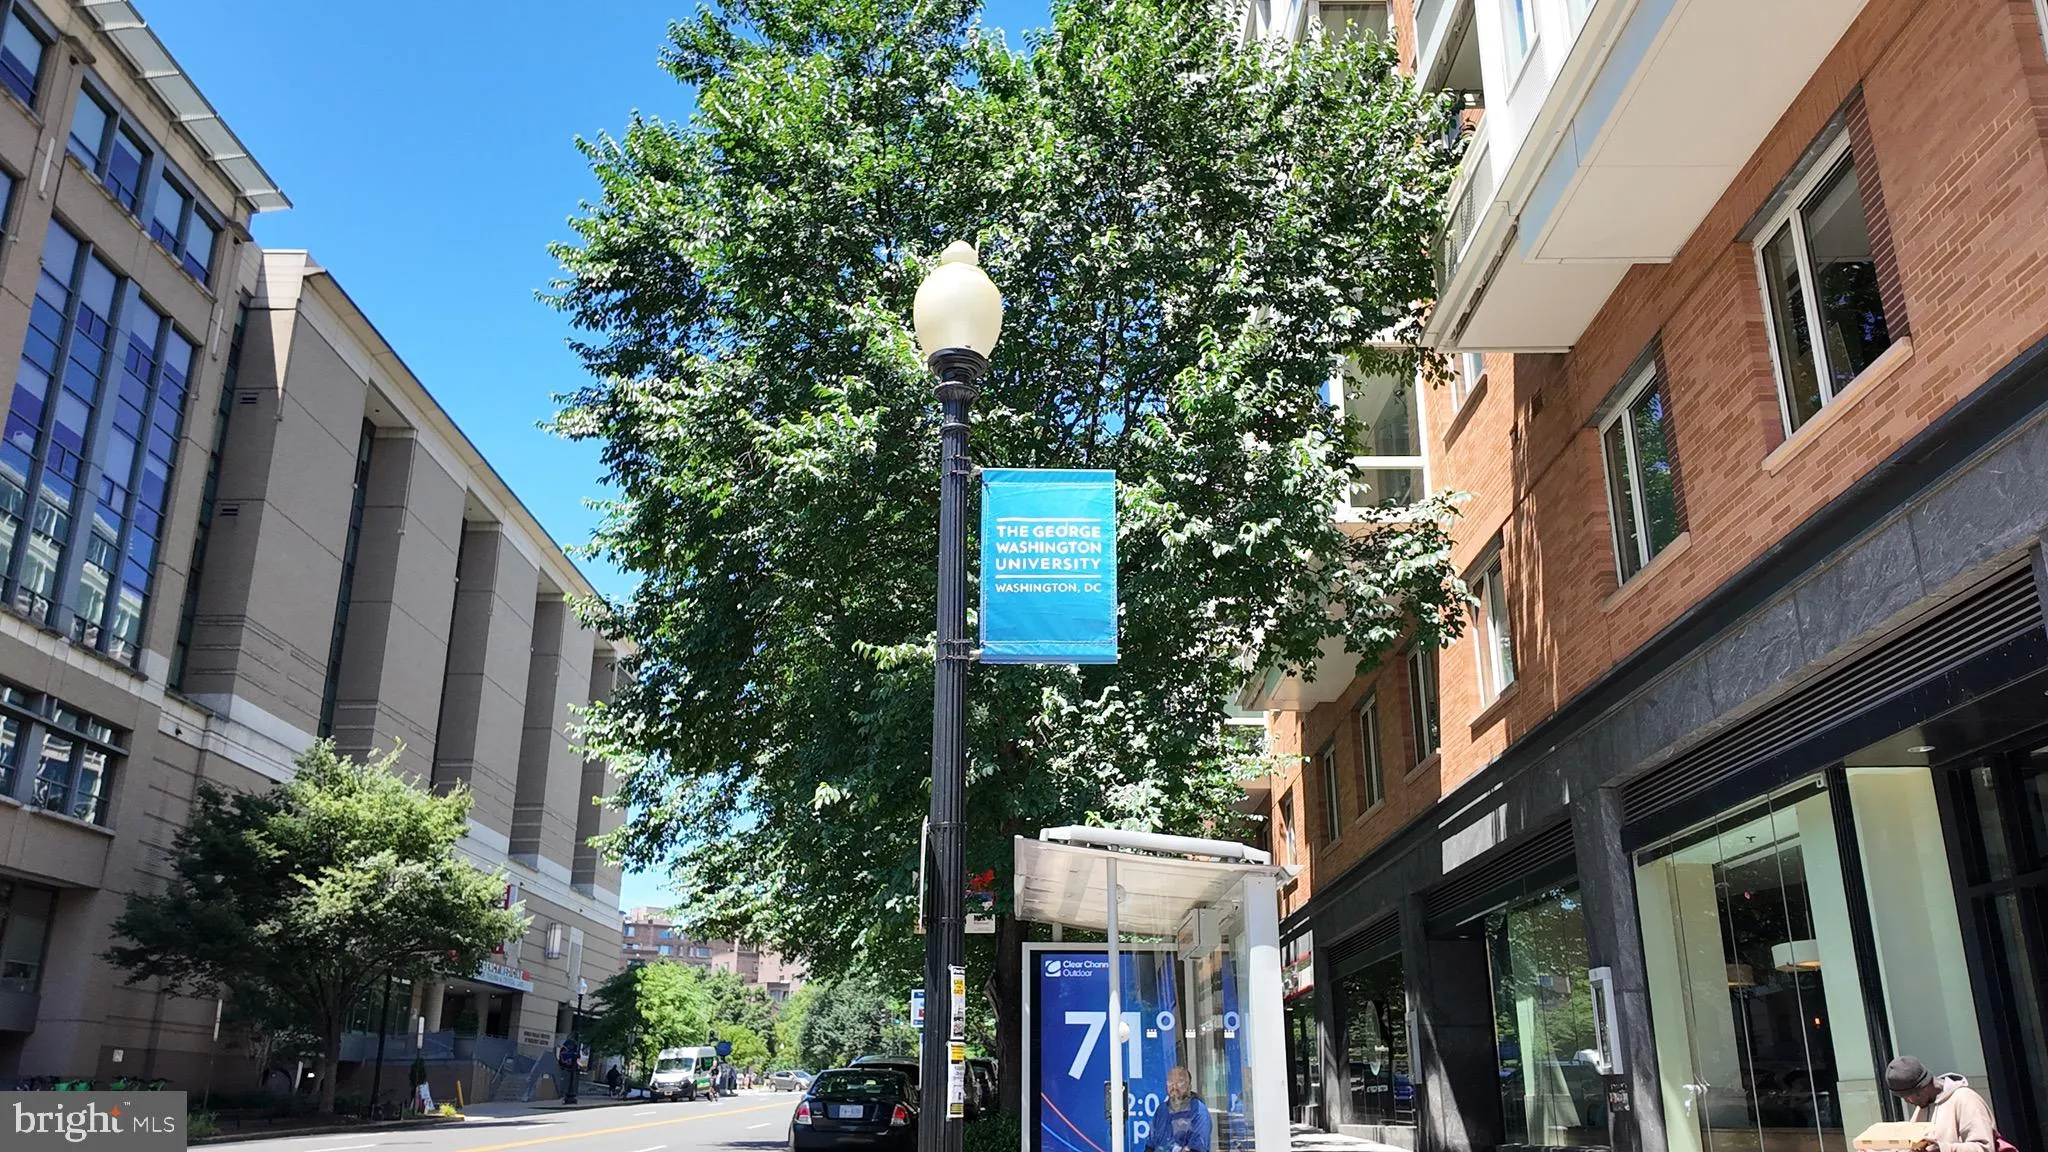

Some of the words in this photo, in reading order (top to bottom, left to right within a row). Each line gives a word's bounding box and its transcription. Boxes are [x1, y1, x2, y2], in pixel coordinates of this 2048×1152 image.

[996, 525, 1029, 538] THE
[1033, 525, 1101, 538] GEORGE
[996, 540, 1102, 555] WASHINGTON
[995, 557, 1102, 571] UNIVERSITY
[995, 582, 1081, 594] WASHINGTON,
[1084, 583, 1102, 593] DC
[1063, 960, 1083, 968] Clear
[1084, 960, 1109, 968] Chann
[1063, 969, 1093, 977] Outdoor
[1128, 1093, 1169, 1117] 2:0
[1133, 1120, 1150, 1144] p
